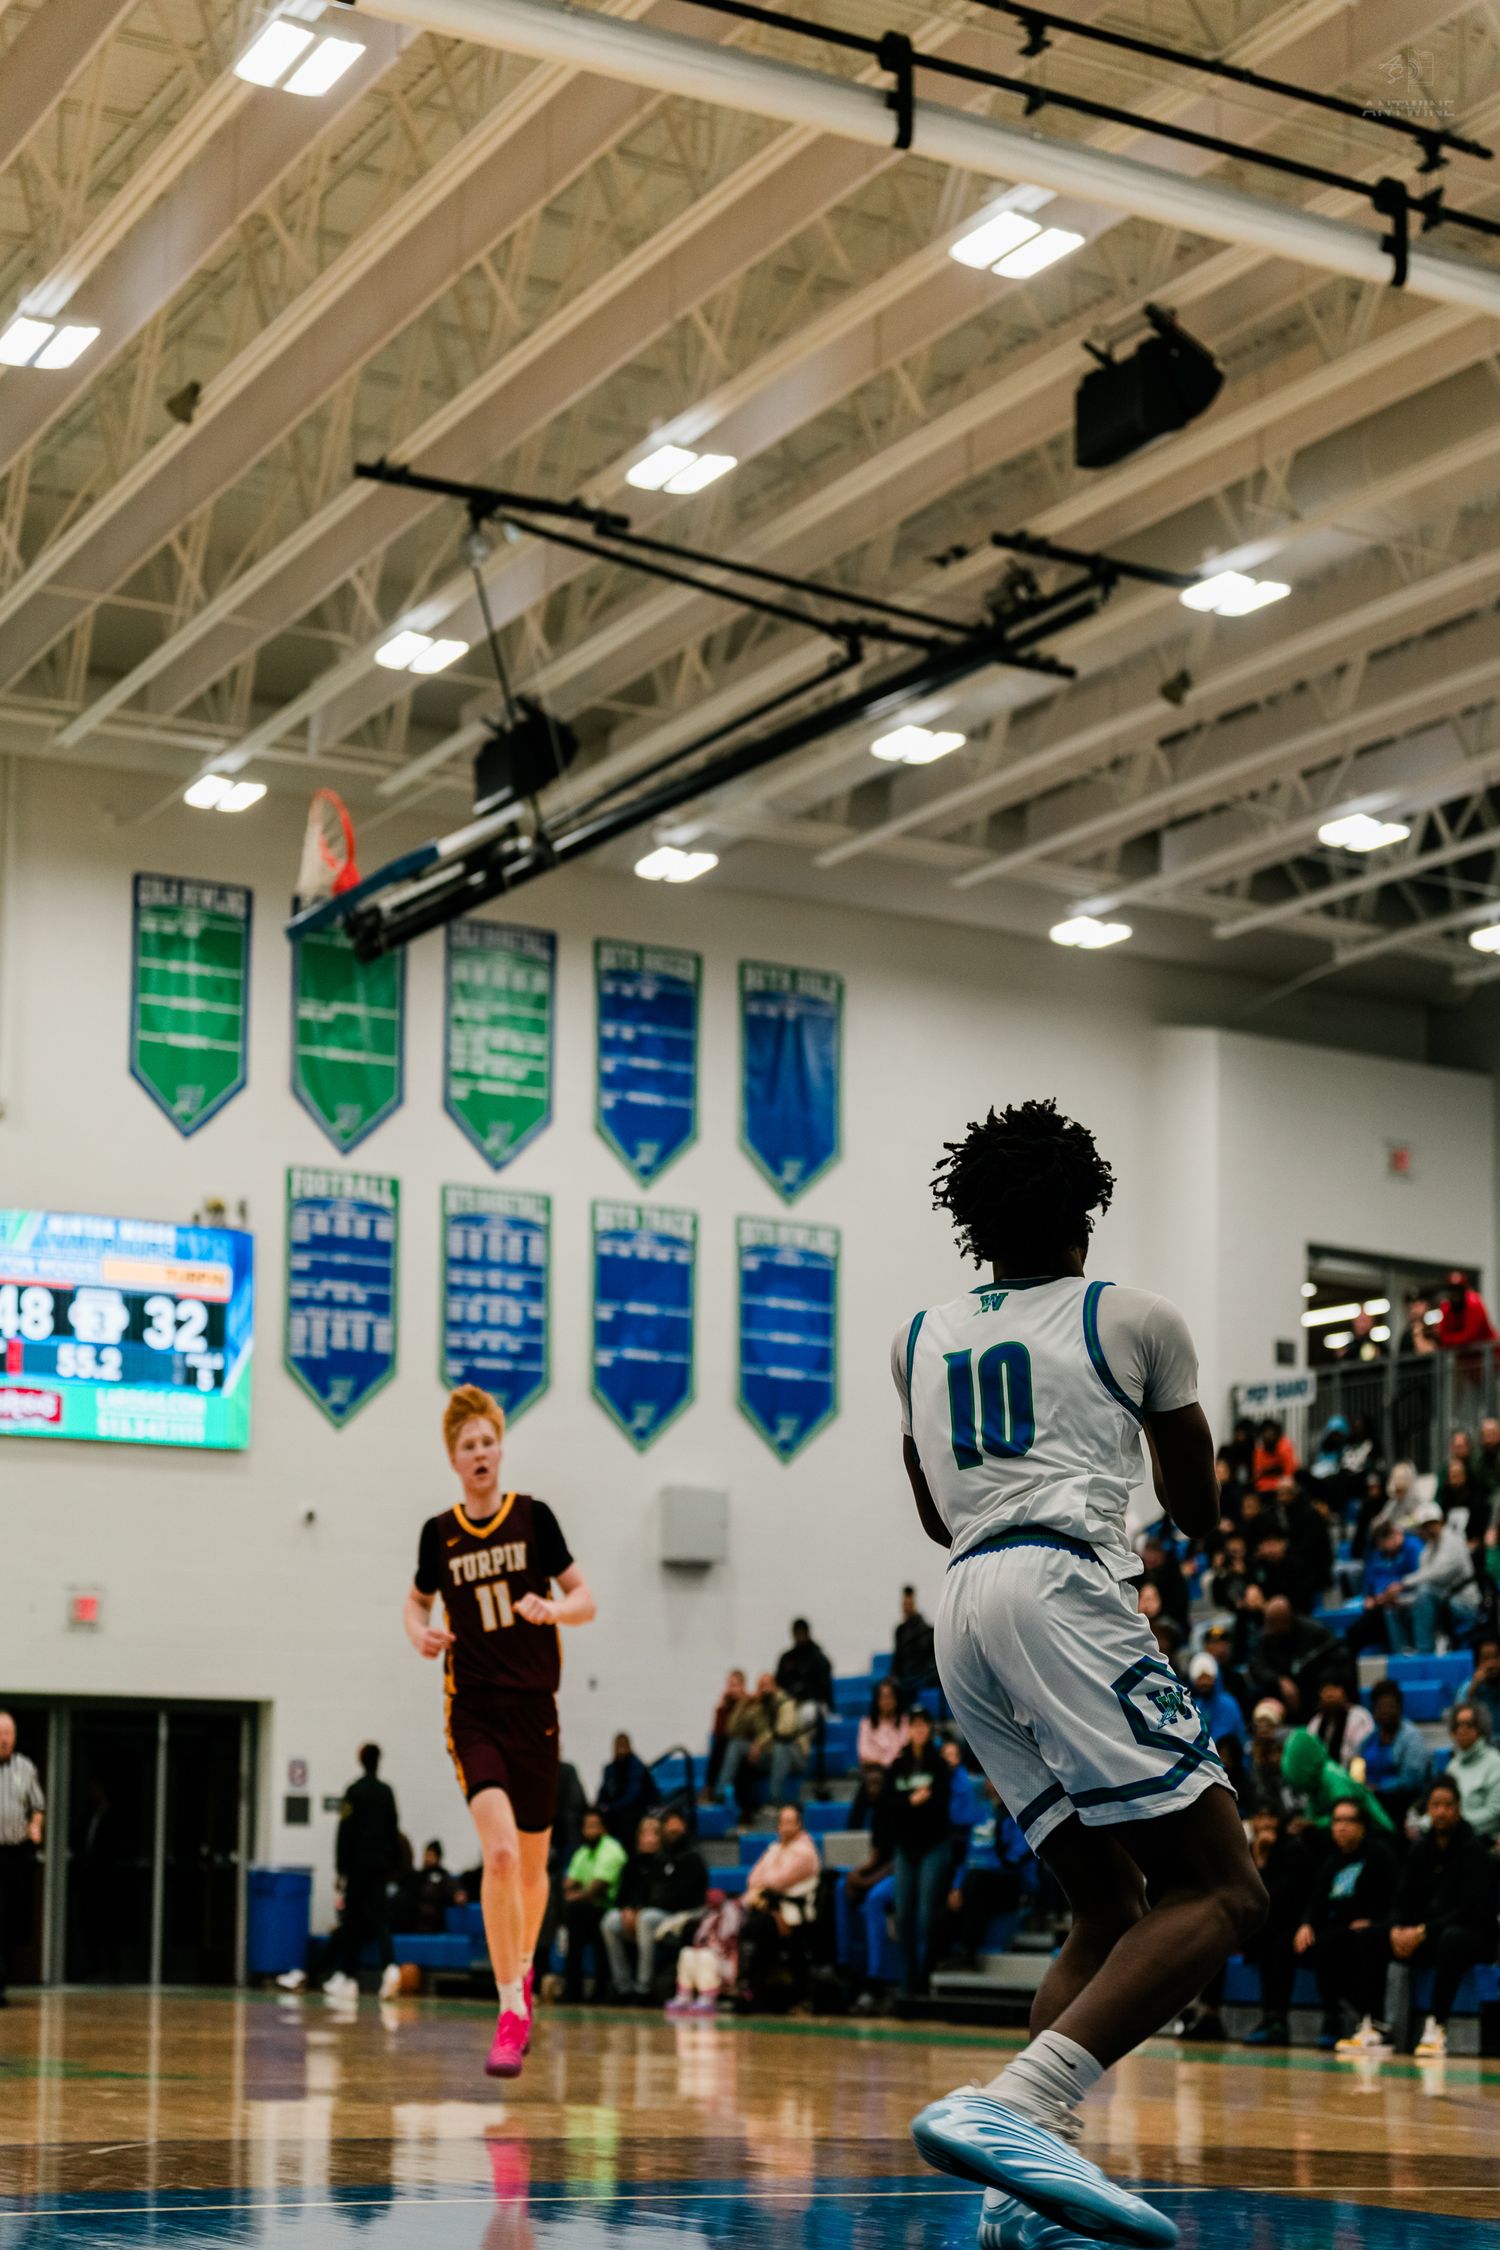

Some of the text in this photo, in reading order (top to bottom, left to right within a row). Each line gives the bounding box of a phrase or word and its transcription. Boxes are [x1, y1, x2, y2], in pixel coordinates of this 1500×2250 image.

[291, 1169, 393, 1208] FOOTBALL
[143, 1295, 208, 1353] 32
[56, 1342, 123, 1382] 55.2
[942, 1340, 1035, 1471] 10
[449, 1540, 527, 1586] TURPIN
[475, 1580, 515, 1633] 11
